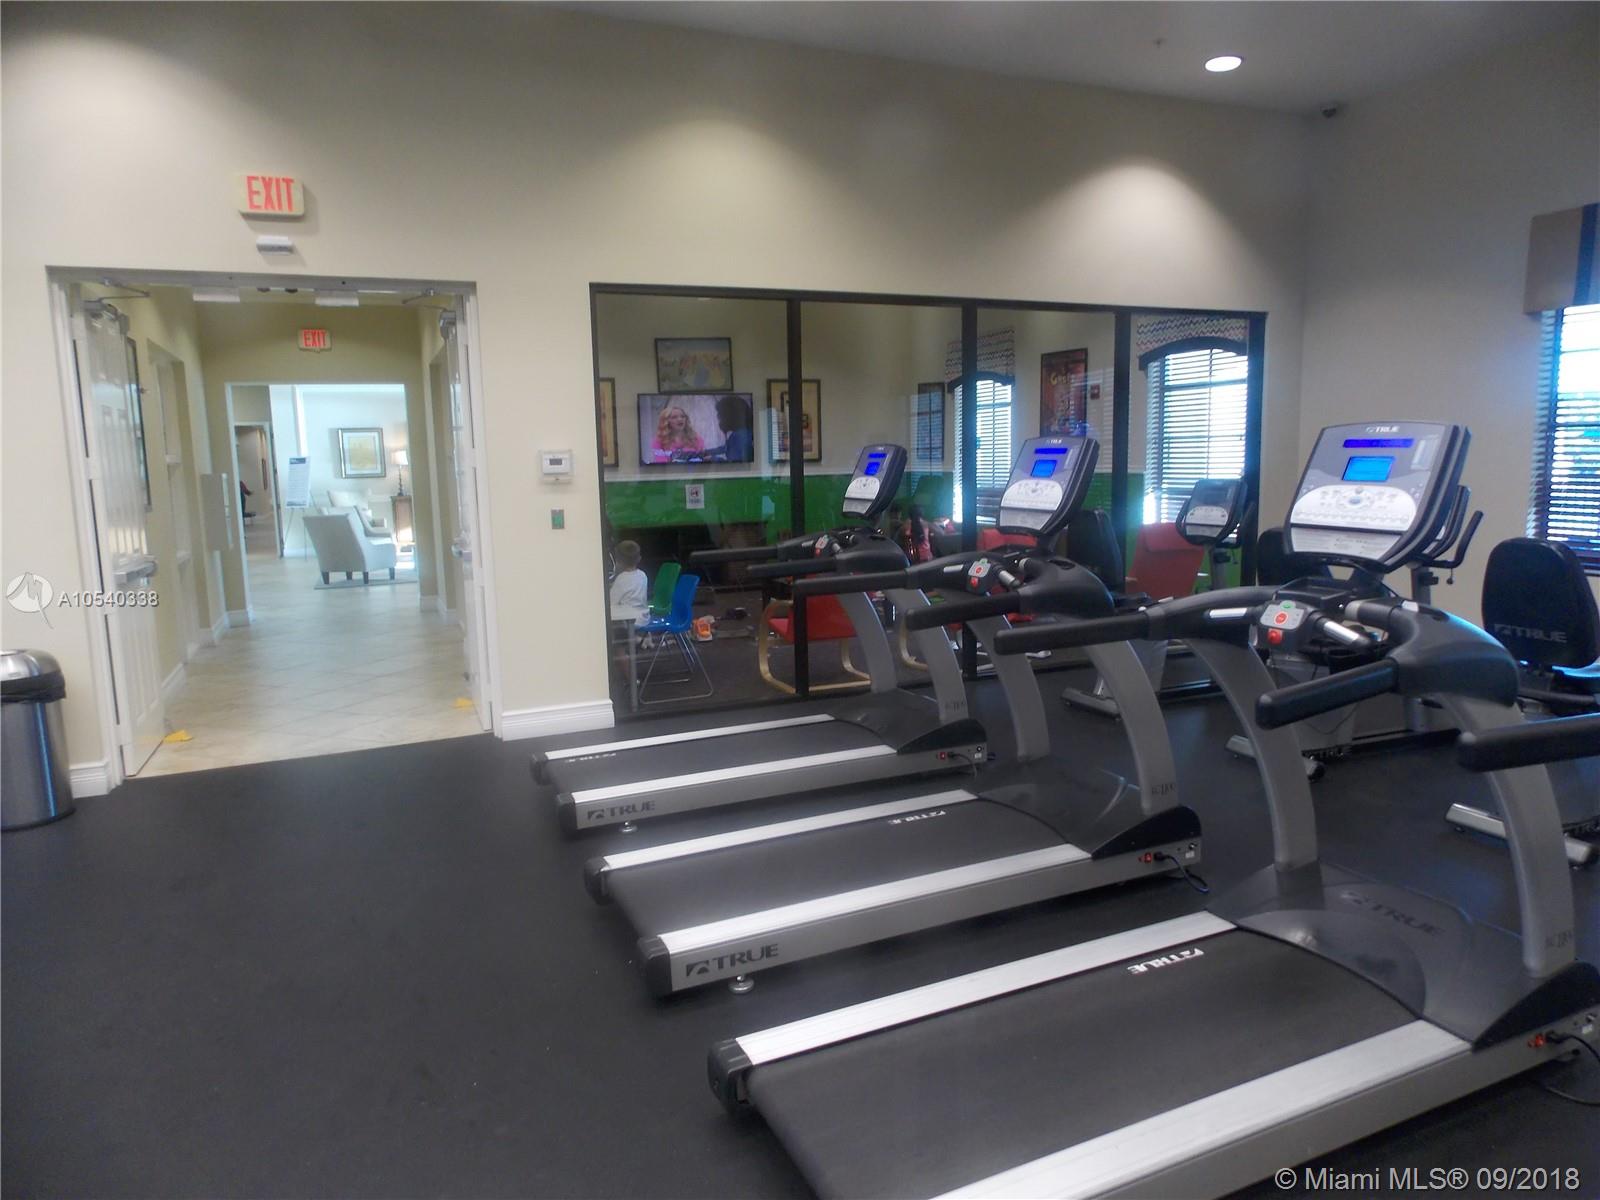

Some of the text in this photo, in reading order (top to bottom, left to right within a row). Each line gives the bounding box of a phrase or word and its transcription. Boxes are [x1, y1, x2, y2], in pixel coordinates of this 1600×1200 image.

[246, 175, 295, 212] EXIT
[303, 329, 327, 347] EXIT
[1511, 626, 1567, 644] TRUE
[606, 800, 656, 817] TRUE
[711, 943, 779, 970] TRUE
[1126, 954, 1182, 975] TRUE
